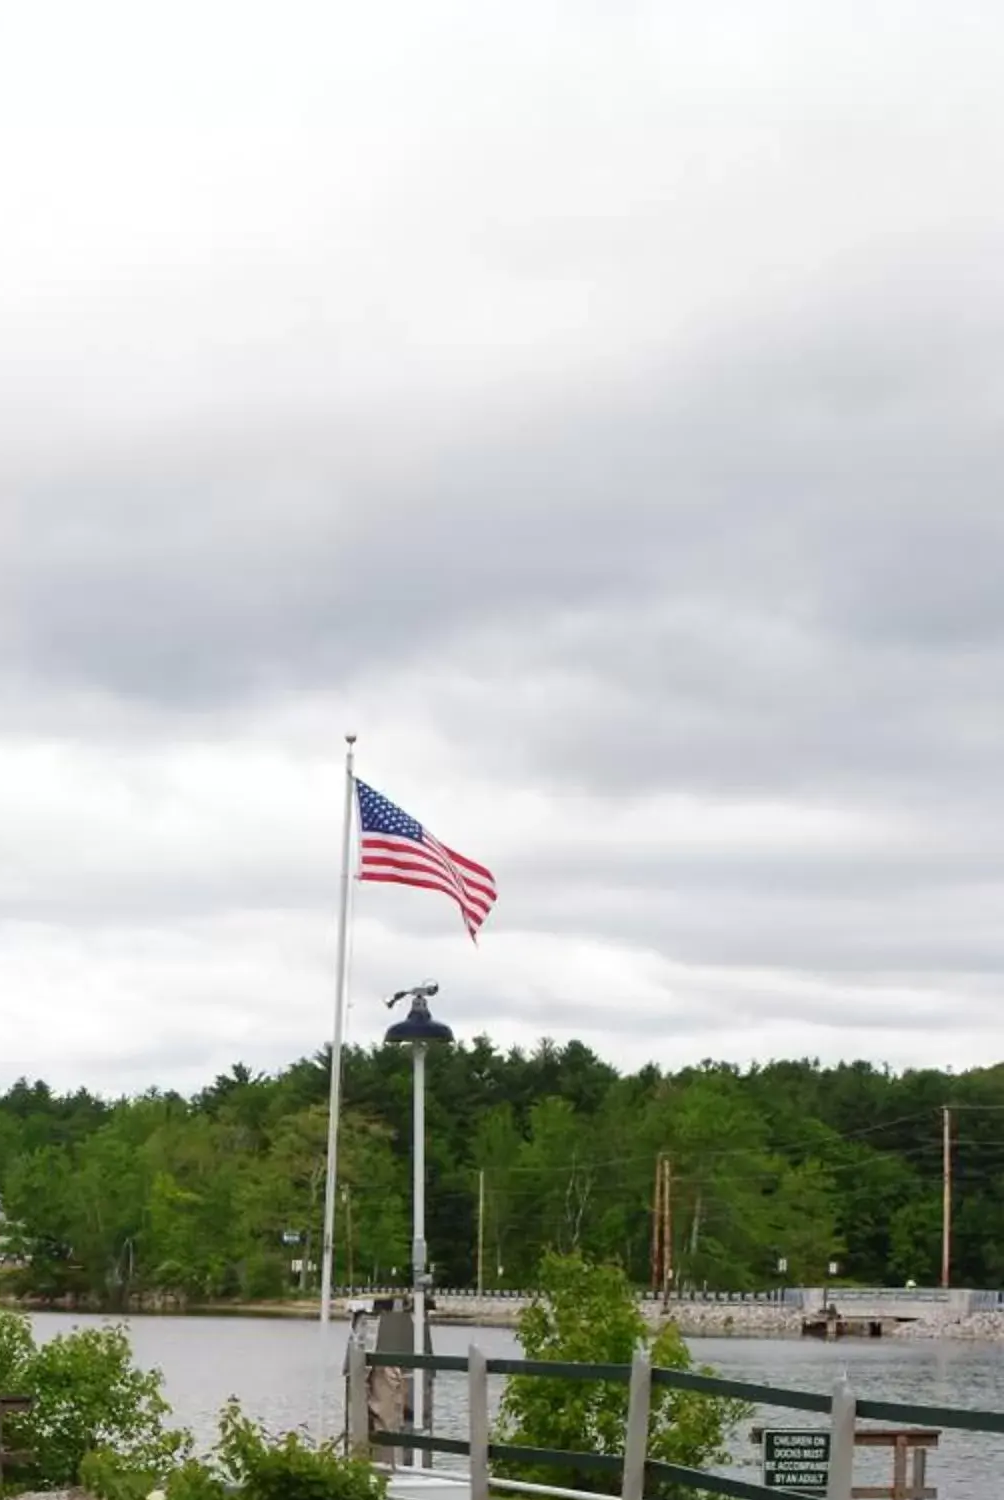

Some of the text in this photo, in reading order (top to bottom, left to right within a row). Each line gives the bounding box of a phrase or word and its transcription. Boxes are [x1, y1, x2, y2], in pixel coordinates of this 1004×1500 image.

[773, 1435, 826, 1446] CHILDREN ON
[774, 1448, 825, 1459] DOCKS MUST
[774, 1473, 824, 1484] BY AN ADULT
